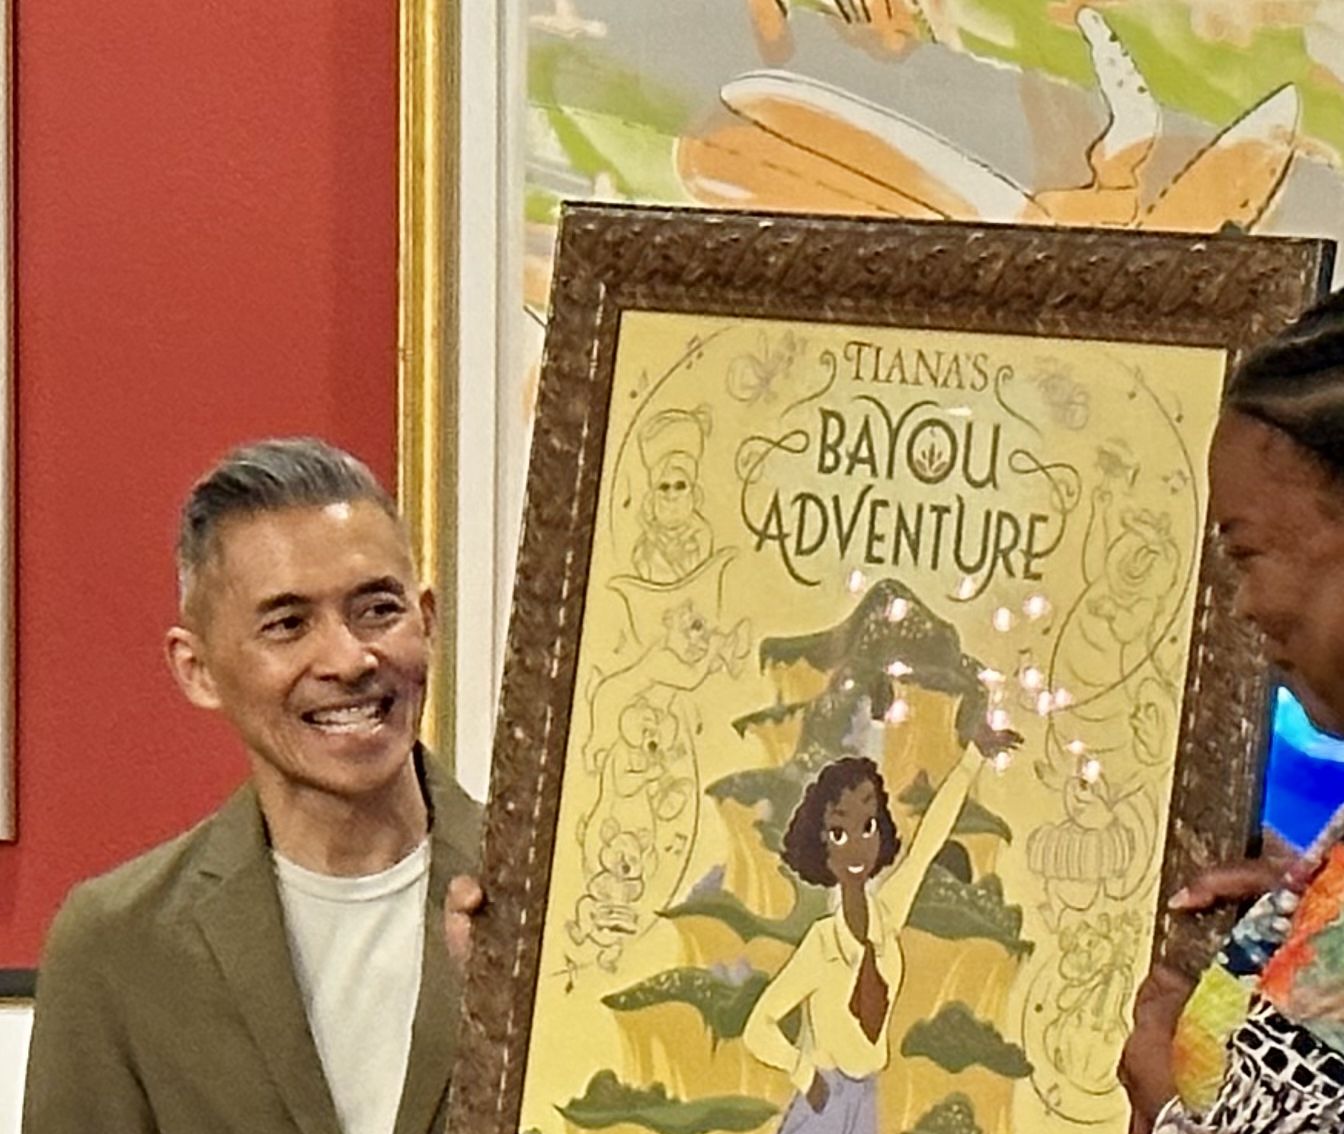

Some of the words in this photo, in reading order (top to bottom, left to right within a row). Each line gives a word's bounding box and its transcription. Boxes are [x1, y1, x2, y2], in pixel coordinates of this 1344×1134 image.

[843, 340, 991, 391] TIANA'S
[817, 396, 1001, 489] BAYOU
[755, 485, 1050, 601] ADVENTURE
